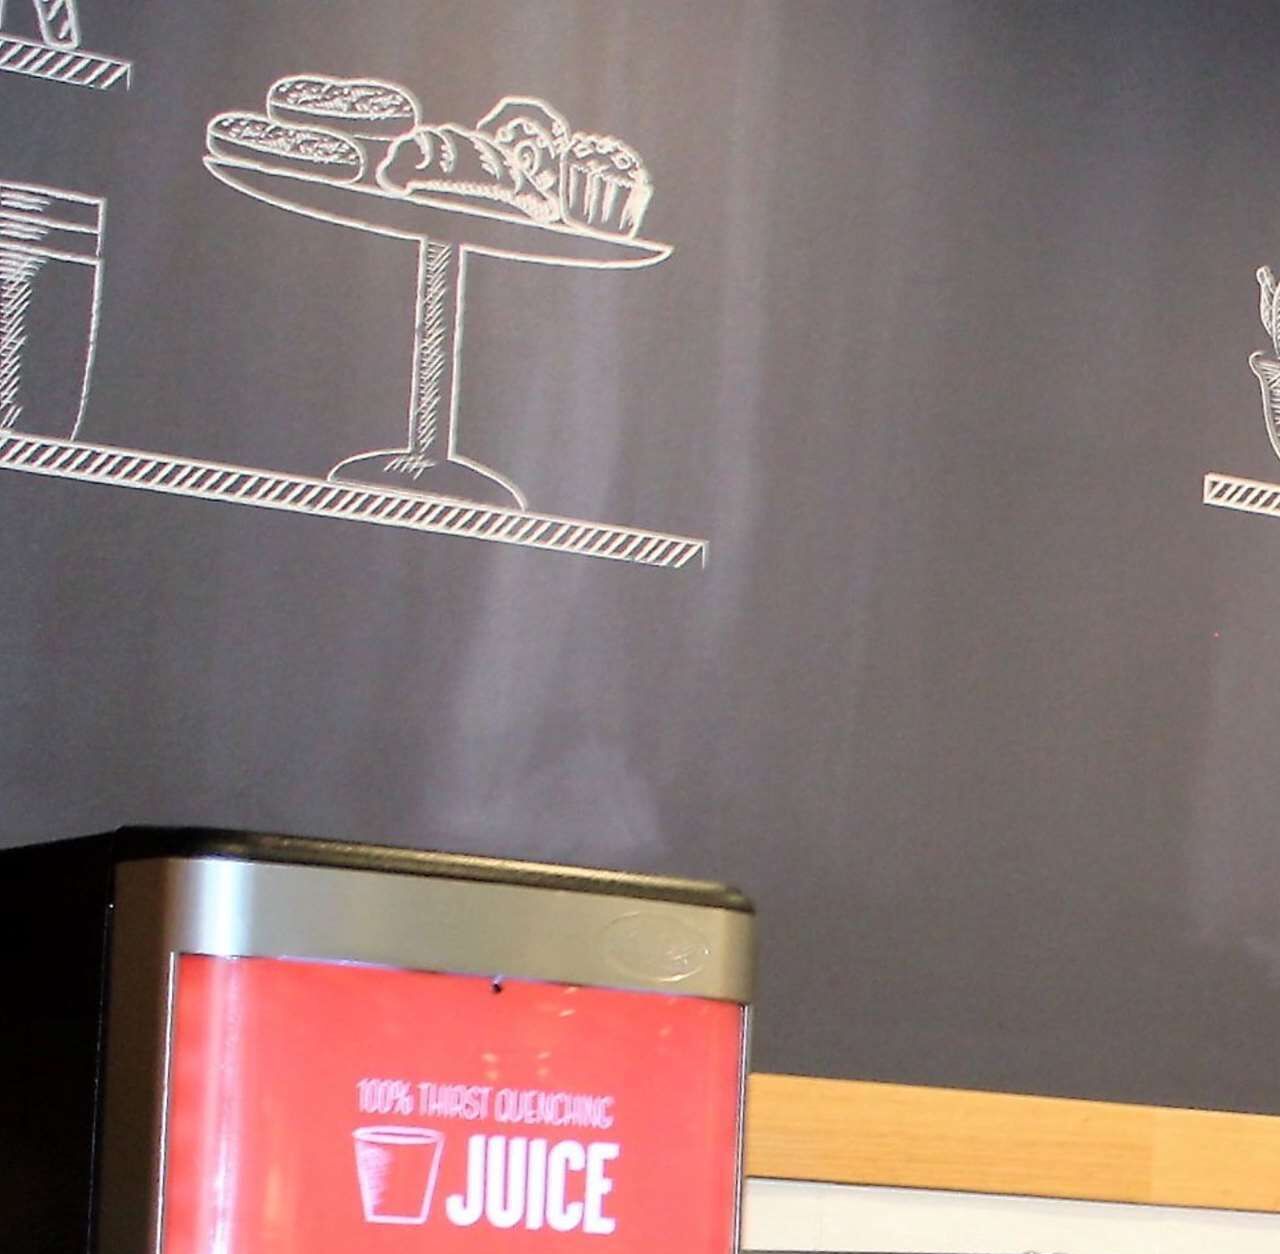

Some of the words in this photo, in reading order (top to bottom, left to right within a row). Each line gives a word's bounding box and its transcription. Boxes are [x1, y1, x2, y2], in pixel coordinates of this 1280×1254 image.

[356, 1078, 414, 1116] 100%
[417, 1082, 494, 1120] THIRST
[495, 1088, 615, 1129] QUENCHING
[445, 1133, 621, 1236] JUICE
